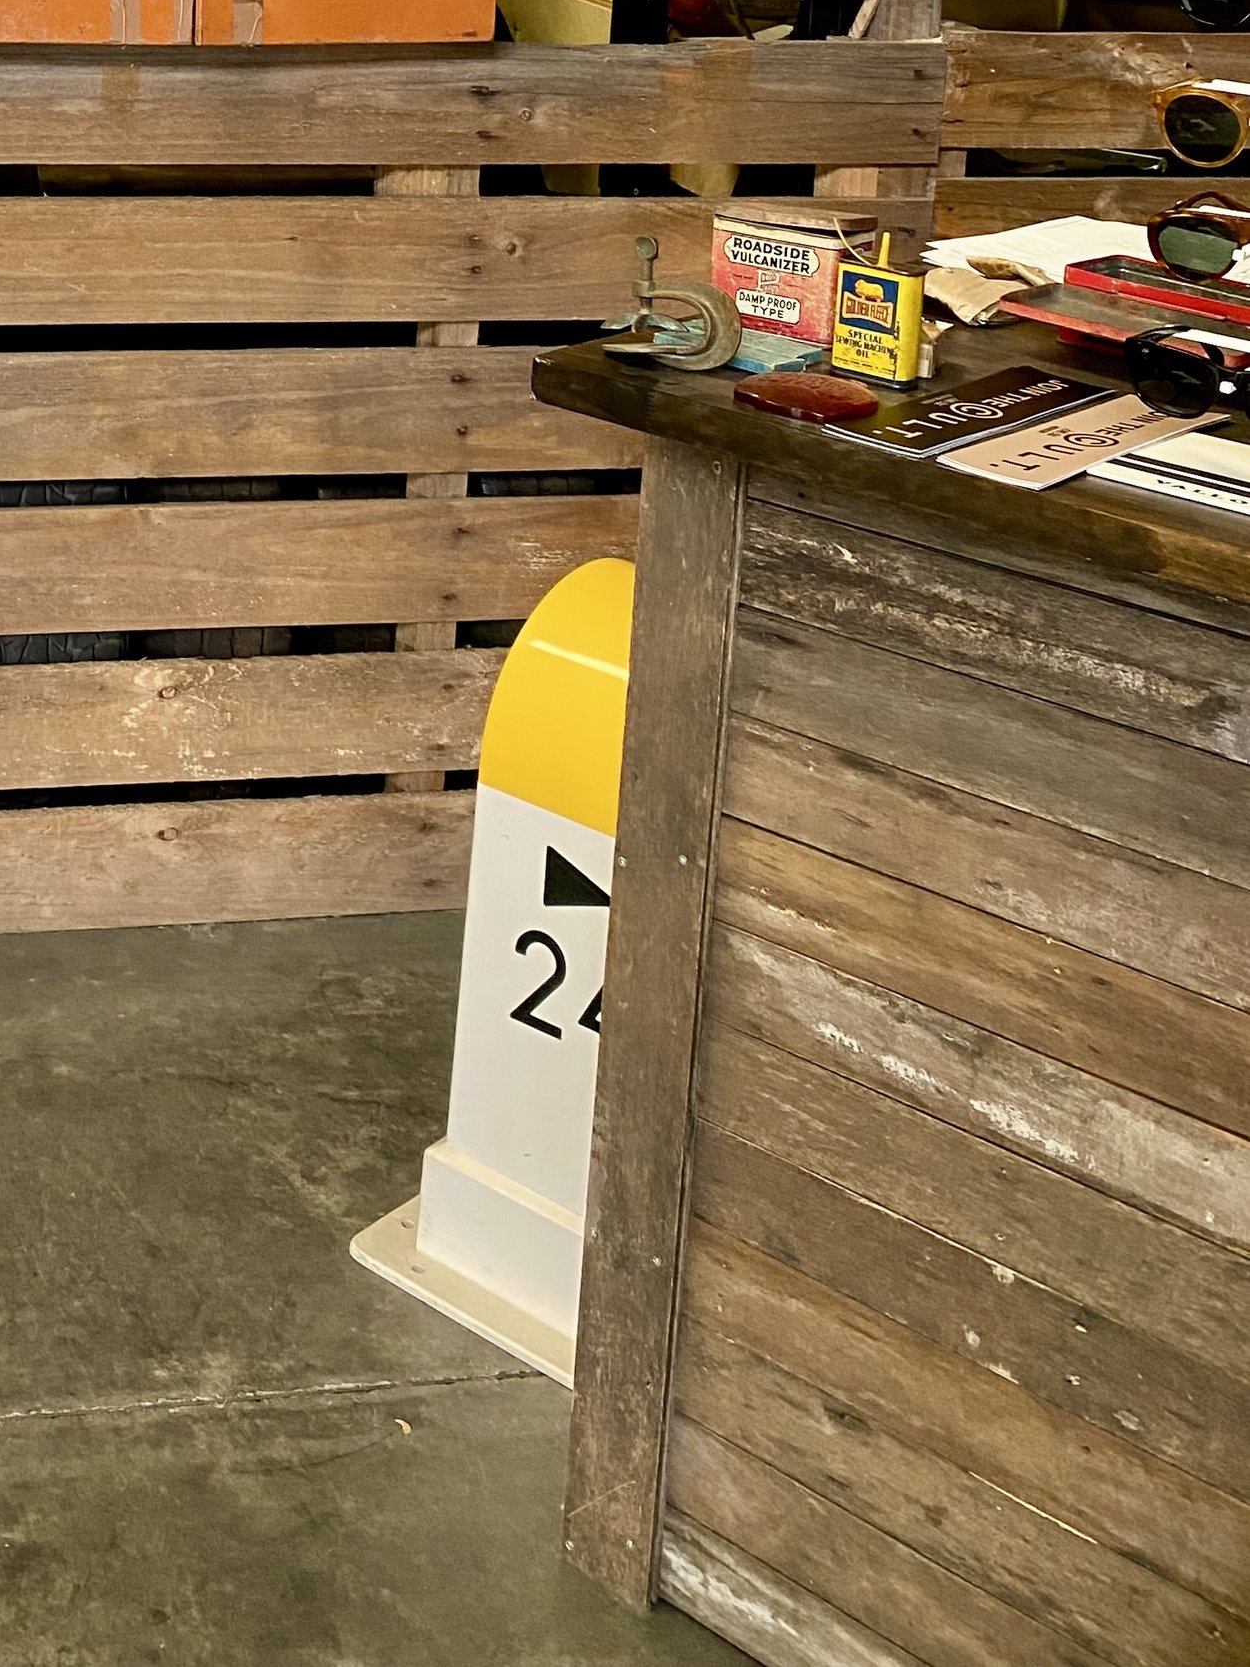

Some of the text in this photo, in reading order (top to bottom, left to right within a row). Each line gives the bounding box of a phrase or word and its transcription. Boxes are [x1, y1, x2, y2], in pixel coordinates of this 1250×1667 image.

[733, 237, 810, 262] ROADSIDE
[731, 249, 811, 275] VULCANIZER
[739, 291, 797, 311] DAMP PROOF
[751, 304, 784, 319] TYPE
[835, 334, 863, 349] SEWING
[848, 329, 883, 344] SPECIAL
[855, 348, 870, 359] OIL
[1018, 379, 1070, 397] JOIN
[980, 391, 1023, 408] THE
[1094, 422, 1135, 437] THE
